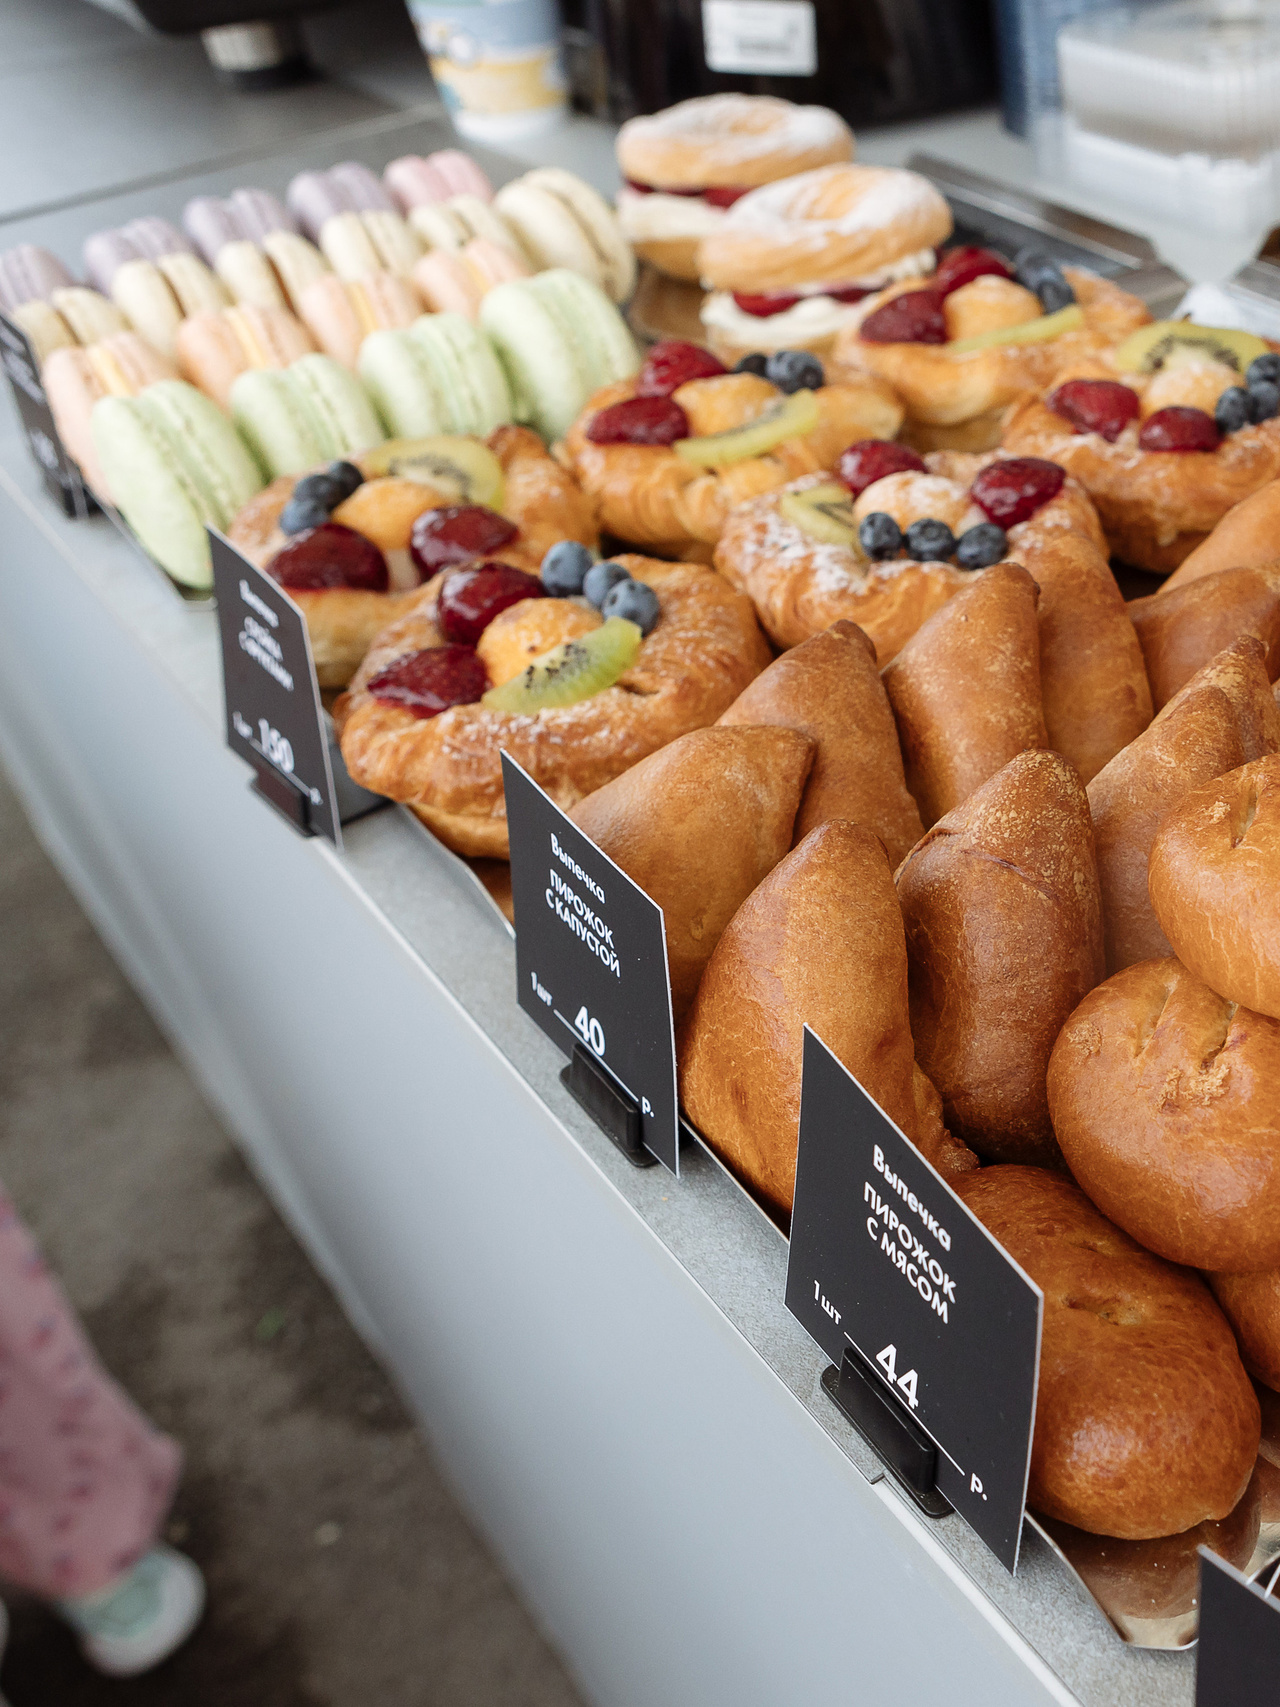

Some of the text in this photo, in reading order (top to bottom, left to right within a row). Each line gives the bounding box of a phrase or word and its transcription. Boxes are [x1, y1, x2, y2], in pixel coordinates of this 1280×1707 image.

[259, 719, 294, 773] 150
[550, 869, 614, 949] ПИРОЖОК
[551, 833, 605, 903] Выпечка
[546, 889, 620, 977] С КАПУСТОЙ
[531, 972, 537, 992] 1
[537, 983, 552, 1006] шт
[575, 1006, 605, 1056] 40
[873, 1145, 951, 1251] Выпечка
[864, 1182, 956, 1303] ПИРОЖОК
[867, 1217, 952, 1324] С МЯСОМ
[814, 1280, 821, 1303] 1
[821, 1295, 841, 1324] шт
[876, 1344, 918, 1407] 44
